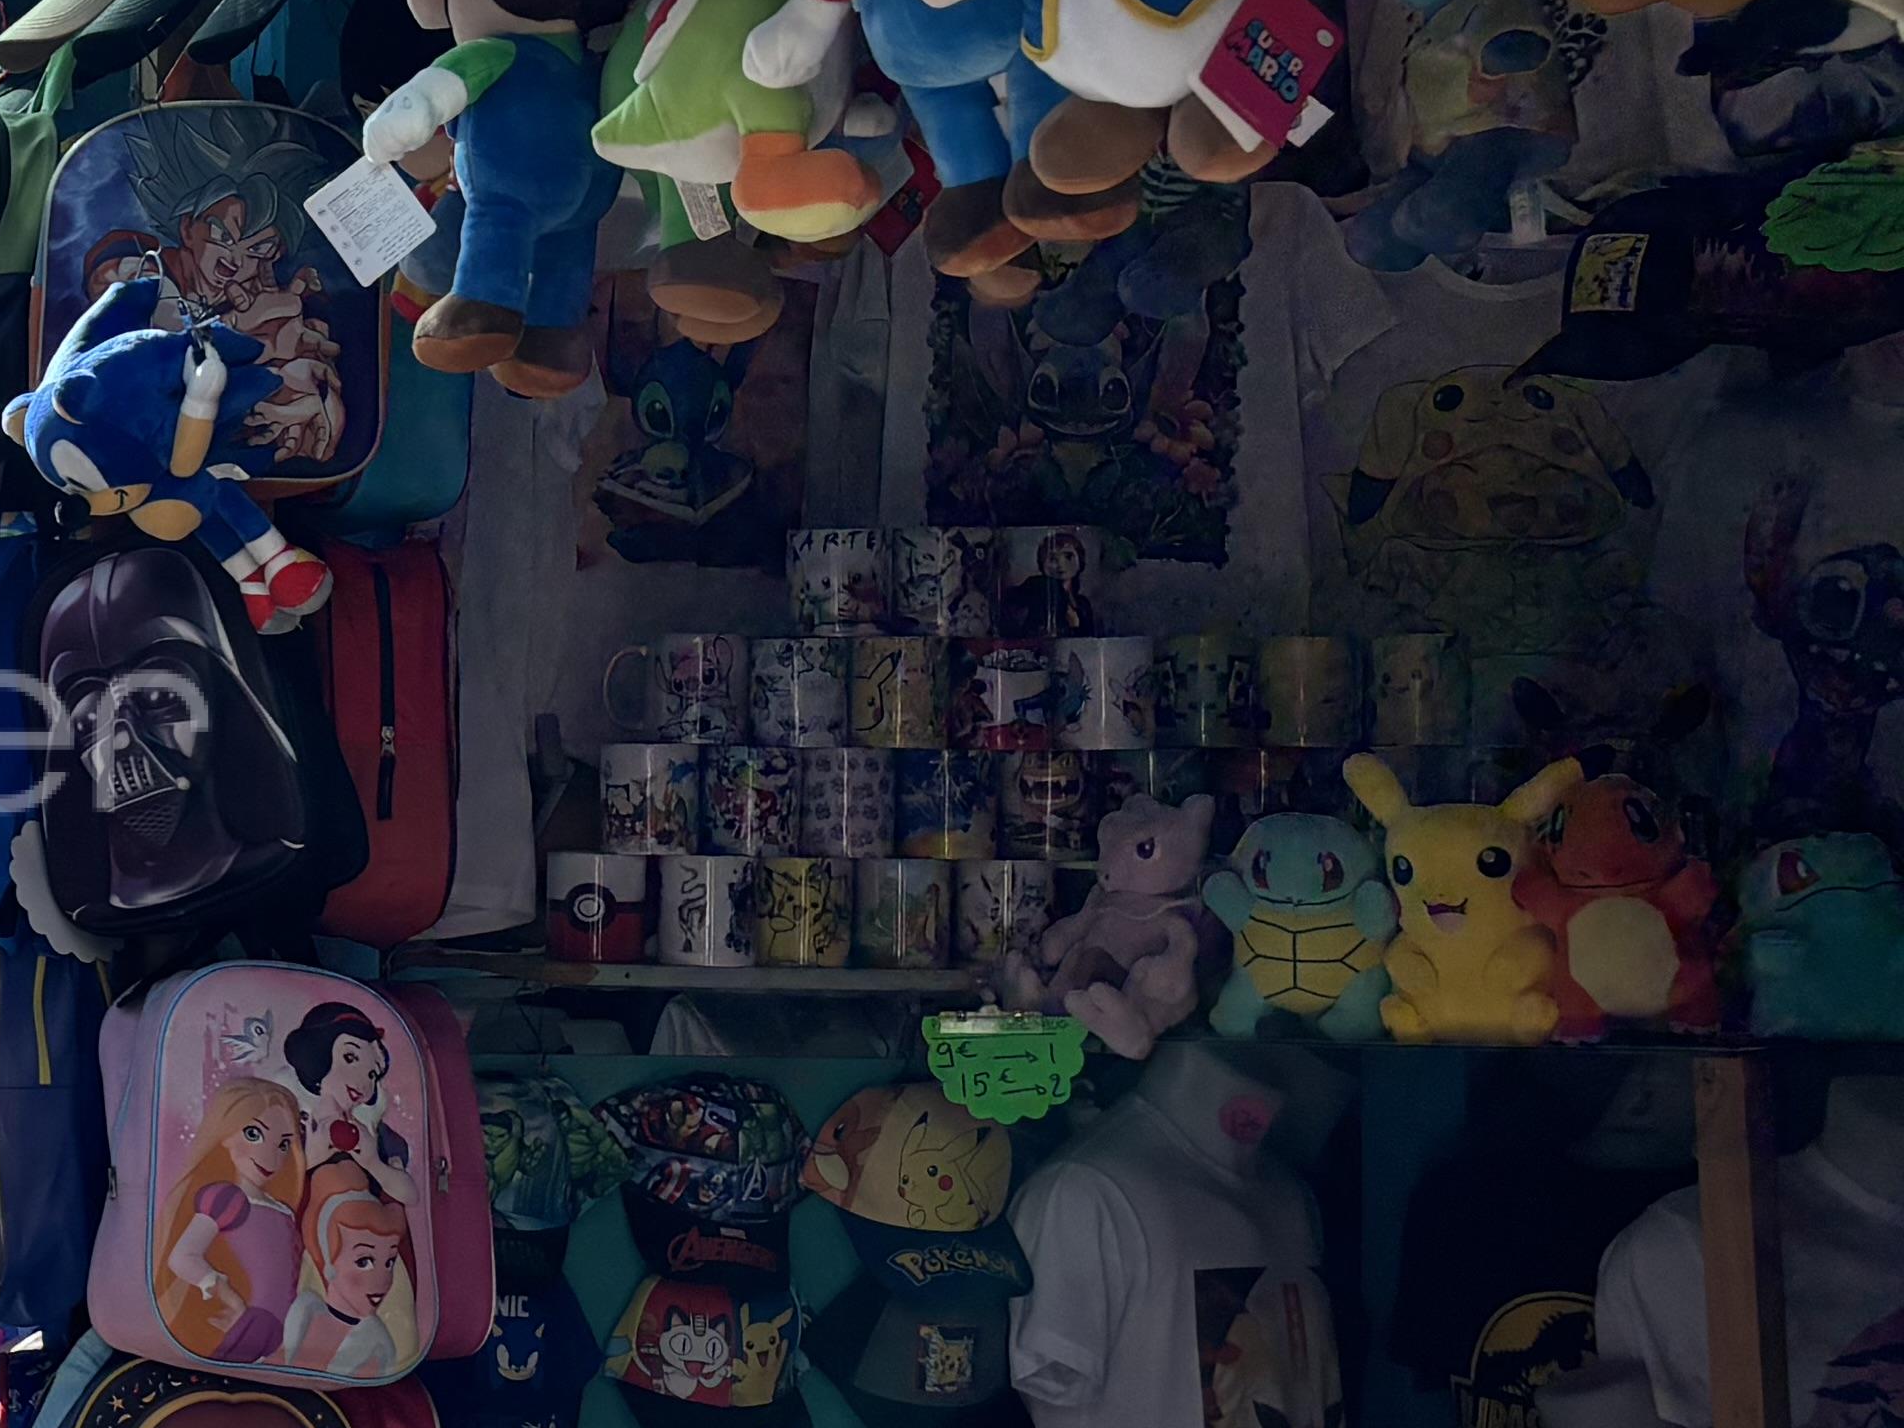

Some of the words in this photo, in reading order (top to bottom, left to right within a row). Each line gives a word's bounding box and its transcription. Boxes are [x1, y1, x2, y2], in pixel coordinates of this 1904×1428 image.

[1226, 33, 1300, 104] MARIO
[1246, 19, 1304, 78] SUPER
[1049, 1073, 1067, 1098] 2
[495, 1295, 530, 1318] NIC
